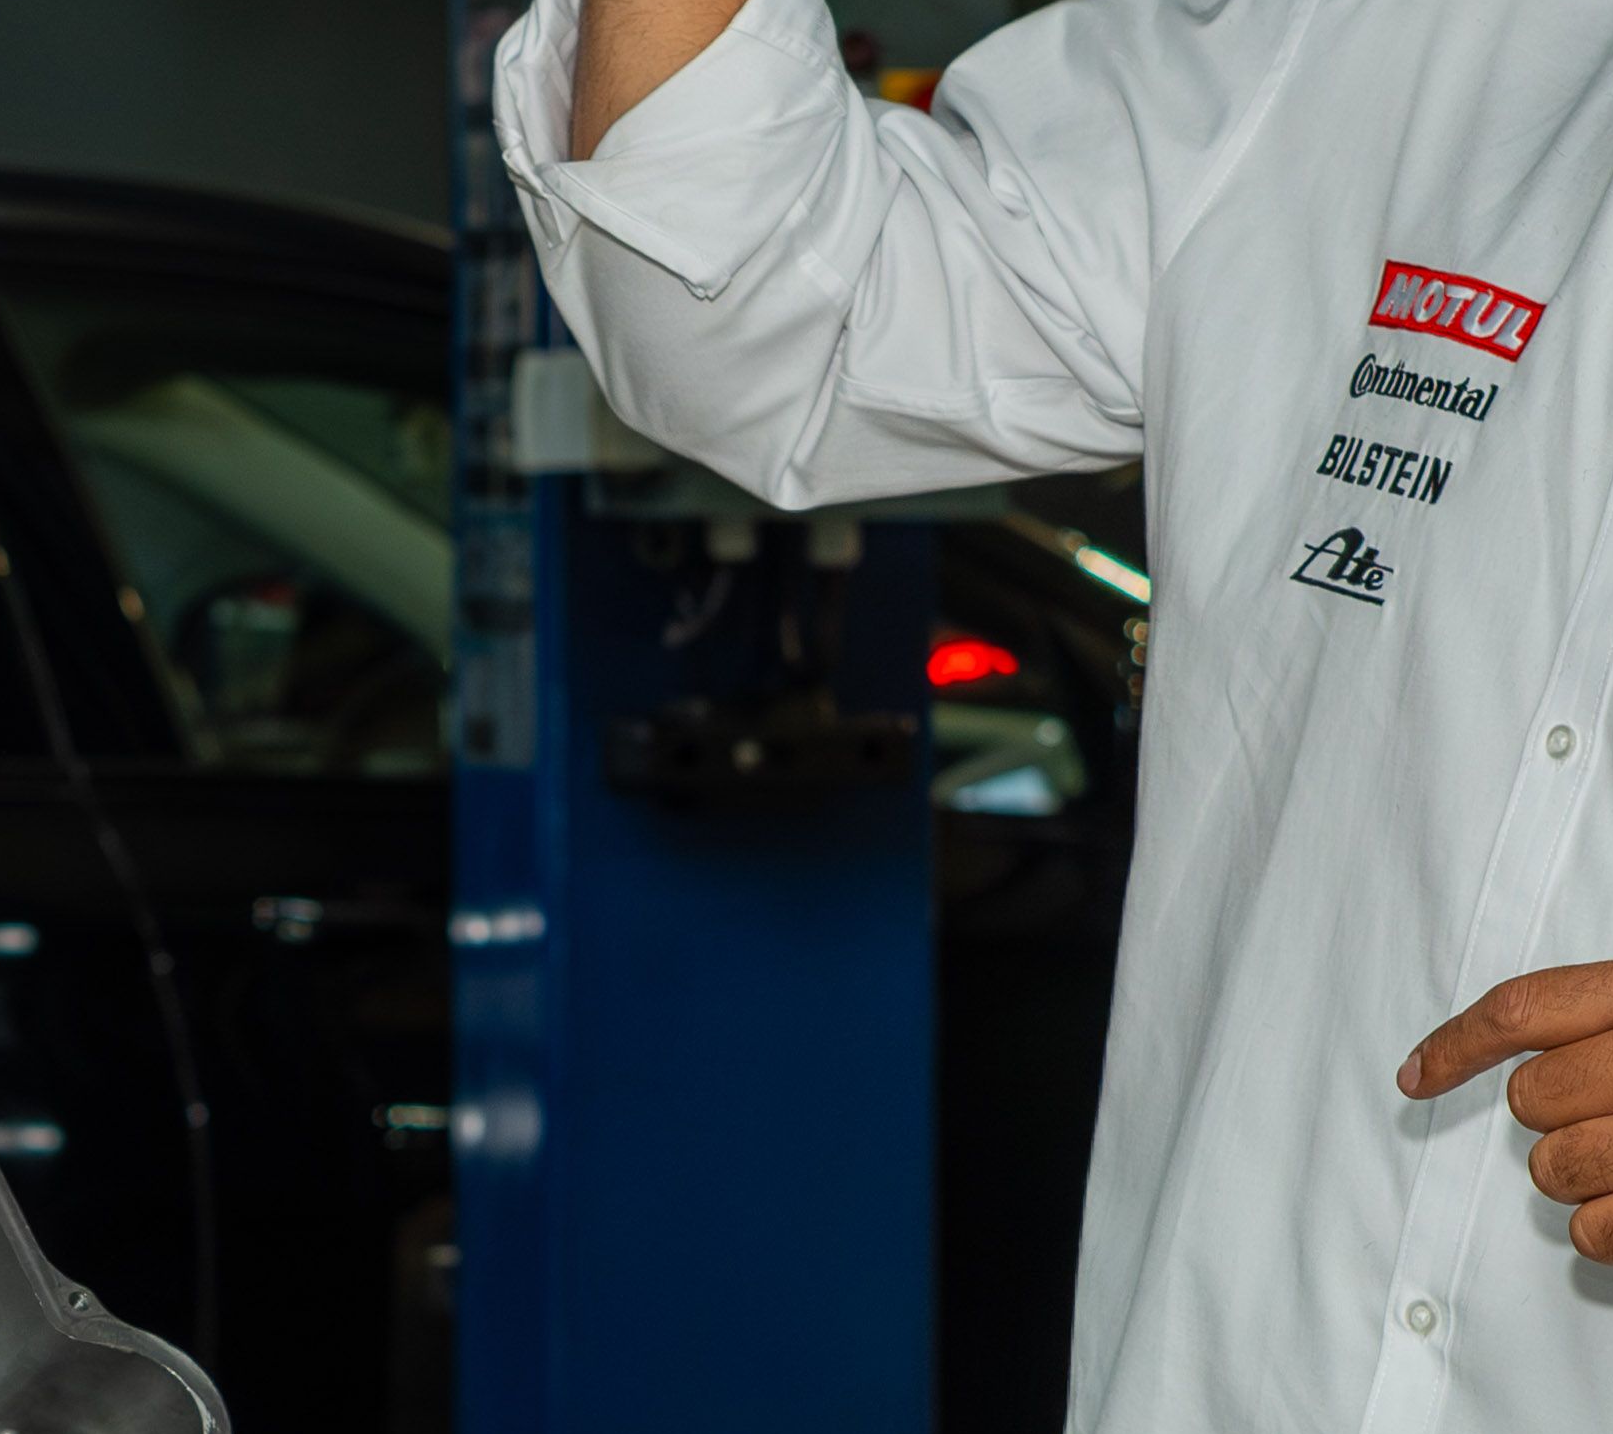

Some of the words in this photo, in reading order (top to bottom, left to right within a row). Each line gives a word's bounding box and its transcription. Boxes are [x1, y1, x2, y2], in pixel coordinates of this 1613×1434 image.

[1377, 270, 1532, 353] MOTUL
[1349, 353, 1499, 422] Continental
[1316, 434, 1453, 505] BILSTEIN
